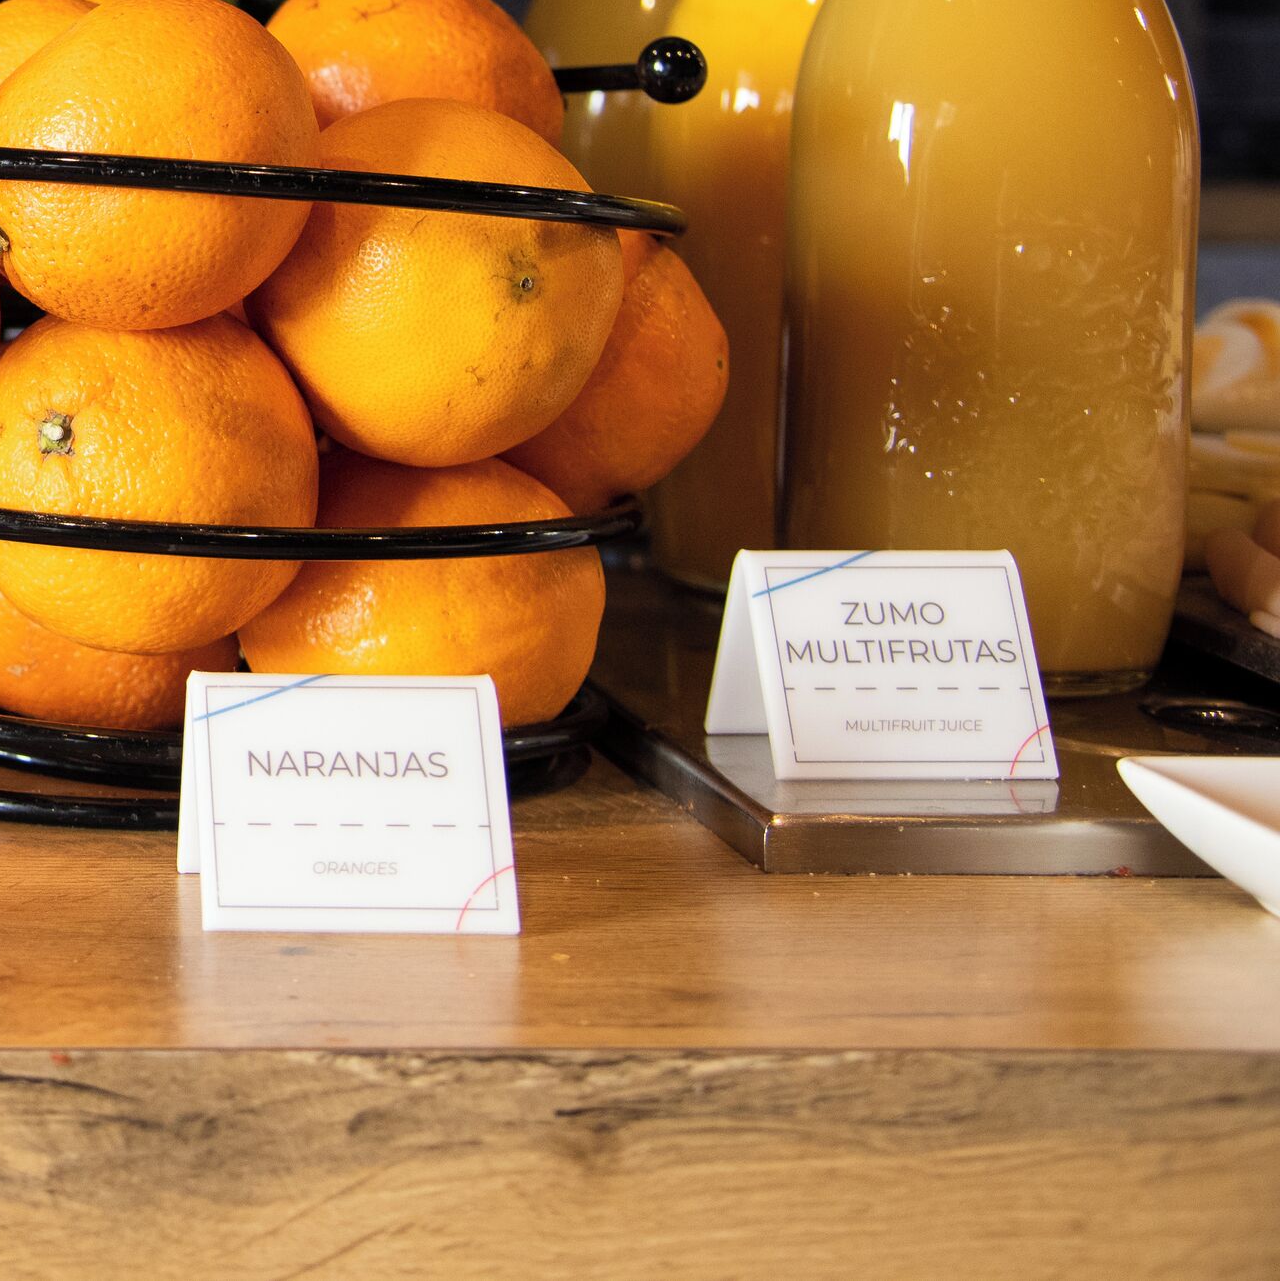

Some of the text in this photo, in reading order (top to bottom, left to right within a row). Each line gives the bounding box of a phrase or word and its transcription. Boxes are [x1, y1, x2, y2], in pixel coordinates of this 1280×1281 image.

[840, 601, 945, 625] ZUMO
[785, 639, 1017, 664] MULTIFRUTAS
[845, 718, 983, 733] MULTIFRUIT JUICE
[247, 750, 449, 778] NARANJAS
[312, 861, 398, 875] ORANGES
